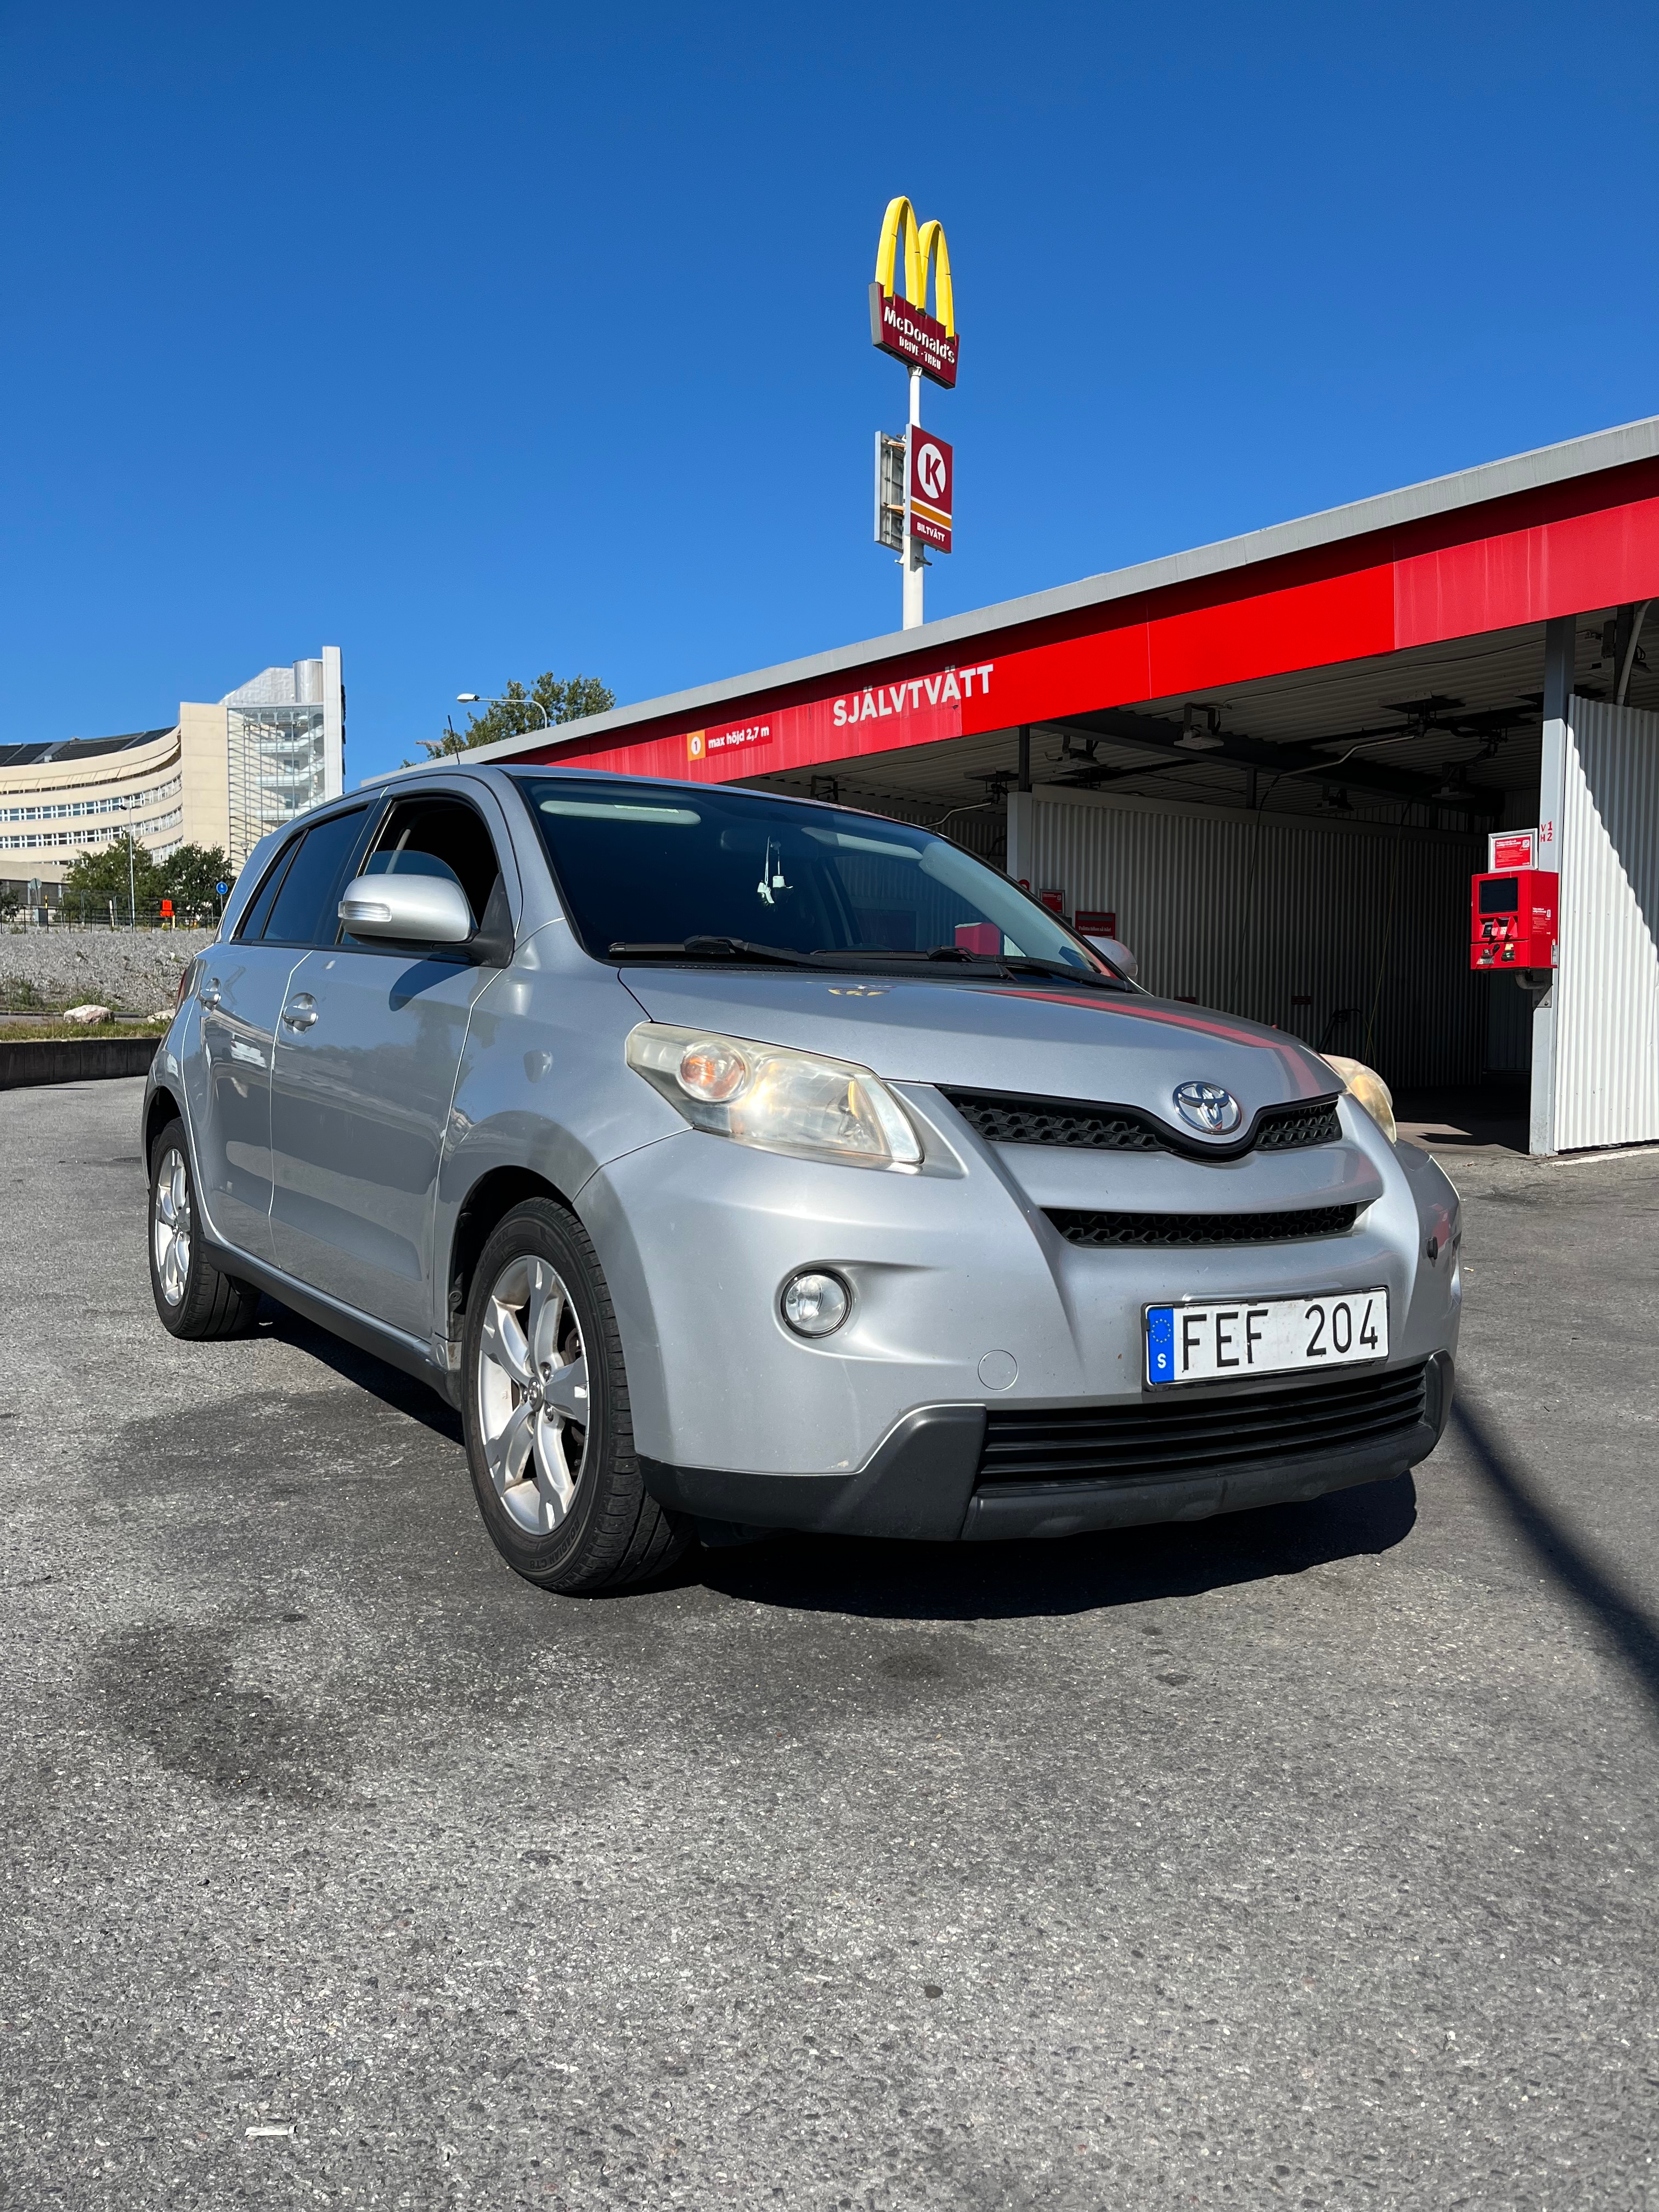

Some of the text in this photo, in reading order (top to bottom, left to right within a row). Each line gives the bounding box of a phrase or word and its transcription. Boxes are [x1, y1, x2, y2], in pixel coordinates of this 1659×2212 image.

[884, 306, 955, 364] McDonald's
[917, 522, 945, 541] BILTVÄTT
[833, 664, 994, 726] SJÄLVTVÄTT
[708, 726, 770, 749] max höjd 2,7 m
[1182, 1299, 1378, 1371] FEF 204
[1157, 1353, 1166, 1369] S
